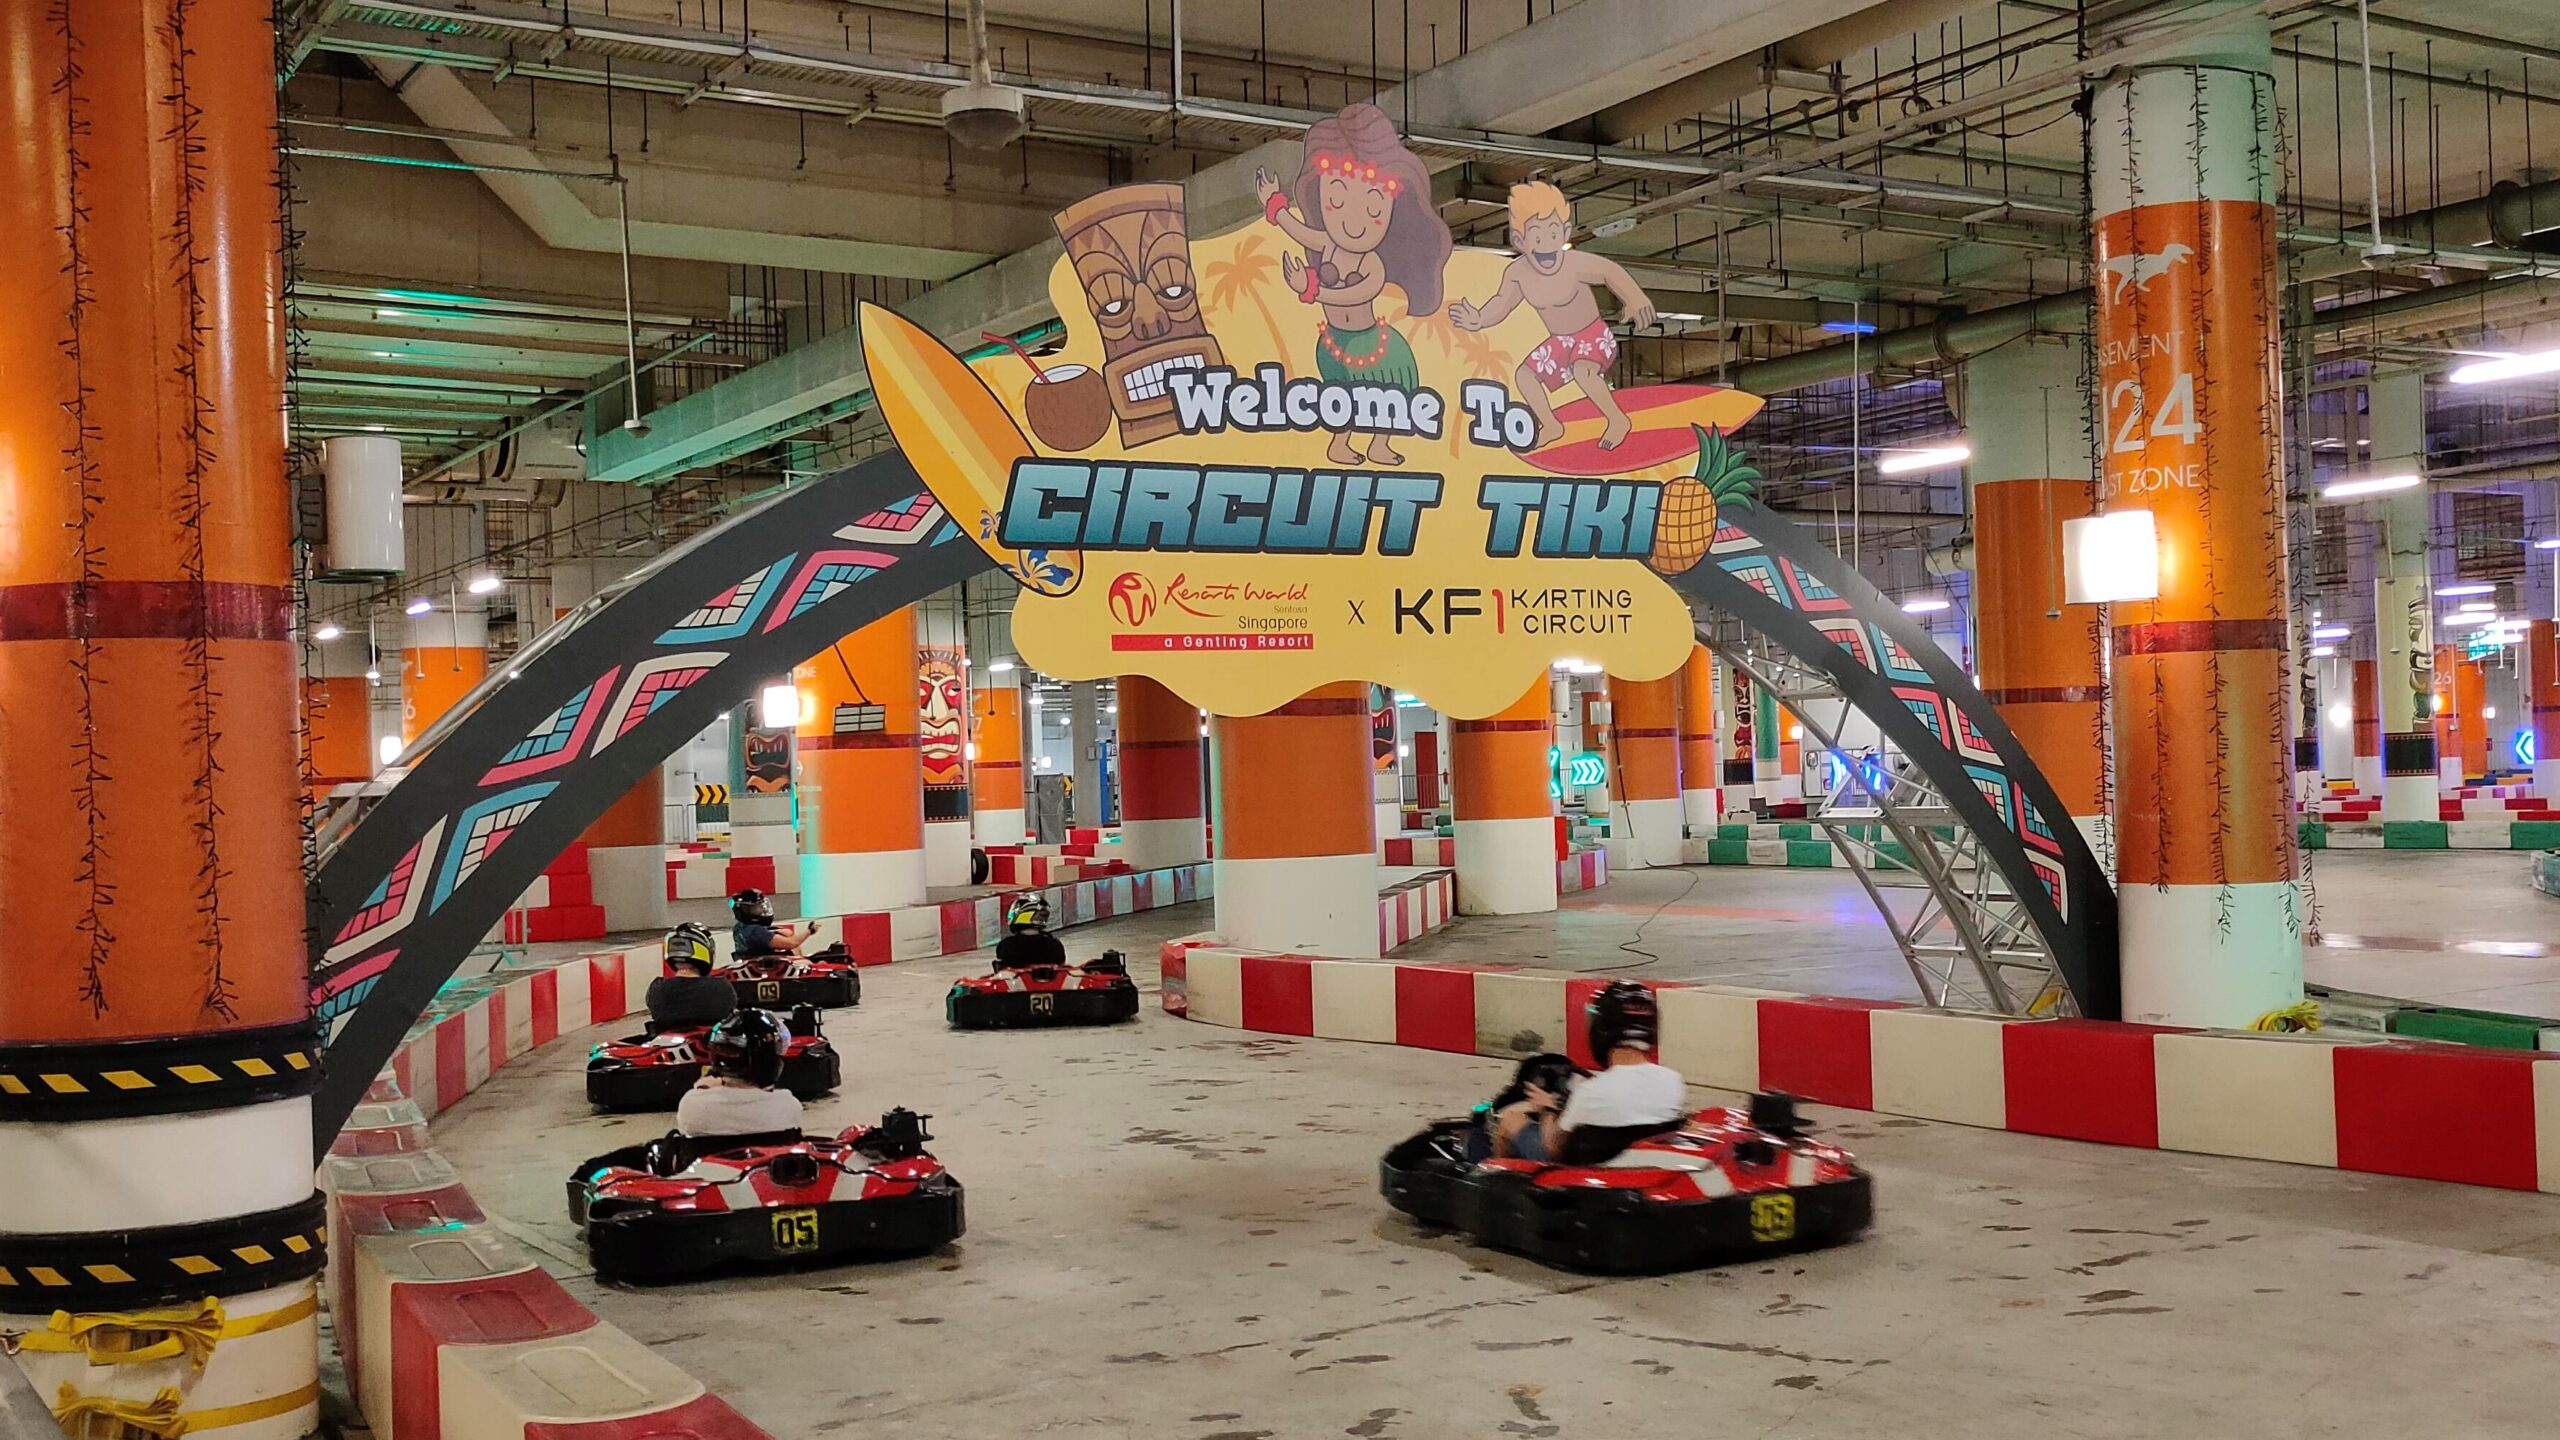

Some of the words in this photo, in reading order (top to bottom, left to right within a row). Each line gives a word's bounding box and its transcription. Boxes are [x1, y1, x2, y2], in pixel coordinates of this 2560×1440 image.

[1167, 366, 1442, 437] Welcome
[1463, 382, 1538, 449] To
[2128, 464, 2201, 493] ZONE
[1001, 462, 1442, 554] CIRCUIT
[1481, 479, 1662, 555] TIKI
[1244, 582, 1309, 601] World
[1511, 588, 1632, 609] KARTING
[1273, 605, 1308, 614] Sentosa
[1394, 588, 1505, 635] KF1
[1238, 616, 1308, 632] Singapore
[1523, 614, 1633, 634] CIRCUIT
[1164, 638, 1173, 648] a
[1183, 636, 1248, 649] Genting
[1258, 635, 1309, 648] Resort
[1031, 995, 1052, 1013] 20
[777, 1215, 814, 1249] 05
